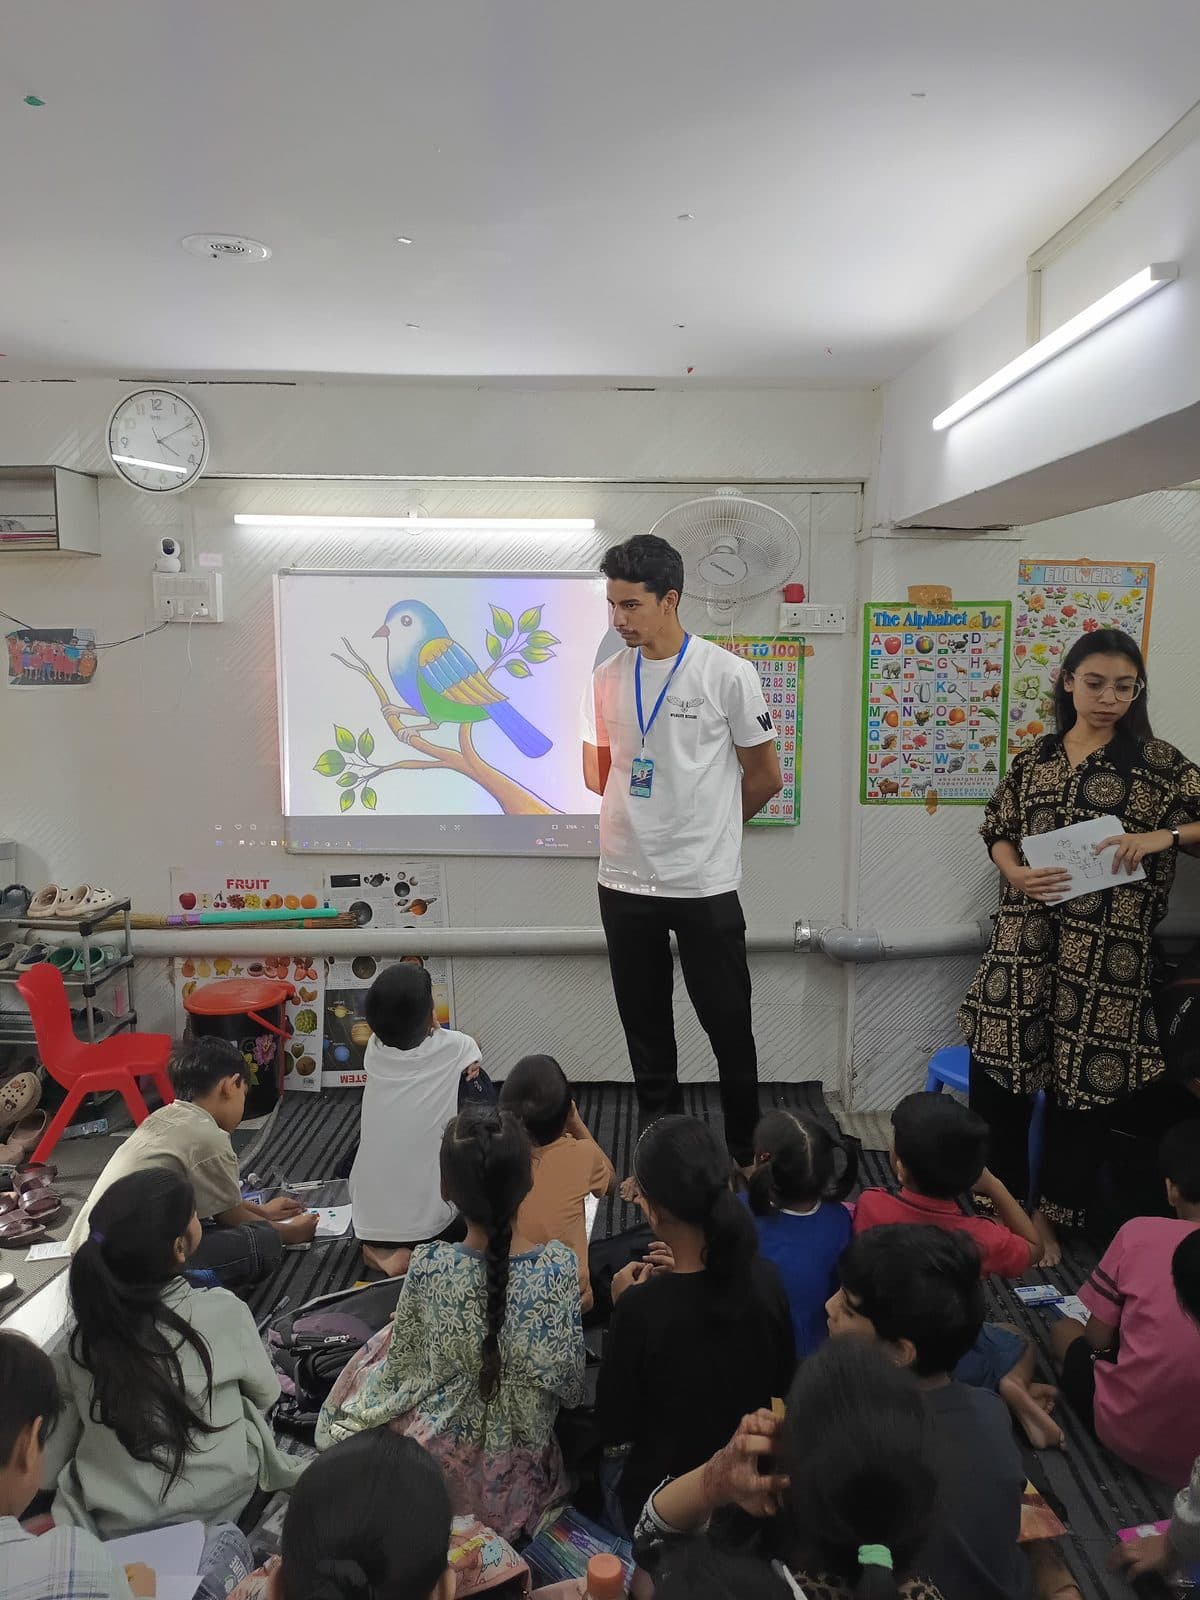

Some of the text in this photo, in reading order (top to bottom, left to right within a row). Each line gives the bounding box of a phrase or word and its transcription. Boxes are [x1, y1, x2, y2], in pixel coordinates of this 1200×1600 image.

[150, 398, 162, 411] 12
[120, 436, 128, 448] 9
[192, 434, 200, 447] 3
[188, 454, 196, 466] 4
[1044, 567, 1121, 584] FLOWERS
[873, 610, 1002, 630] The Alphabet abc
[872, 632, 981, 646] A B C D
[752, 644, 768, 656] TO
[772, 644, 797, 657] 100
[761, 661, 771, 671] 71
[774, 662, 783, 672] 81
[787, 662, 796, 672] 91
[870, 657, 980, 669] E F G H
[761, 678, 796, 688] 72 82 92
[904, 682, 911, 693] J
[936, 681, 946, 693] K
[970, 681, 977, 692] L
[773, 694, 782, 703] 83
[786, 694, 795, 704] 93
[772, 709, 795, 720] 84 94
[870, 706, 978, 717] M N O P
[756, 712, 772, 732] W
[785, 725, 794, 735] 95
[869, 729, 978, 741] Q R S T
[784, 741, 794, 751] 96
[784, 757, 793, 766] 97
[869, 753, 977, 764] U V W X
[784, 773, 793, 783] 98
[868, 777, 910, 787] Y Z
[783, 789, 792, 798] 99
[770, 804, 779, 814] 90
[783, 804, 792, 814] 100
[226, 879, 270, 890] FRUIT
